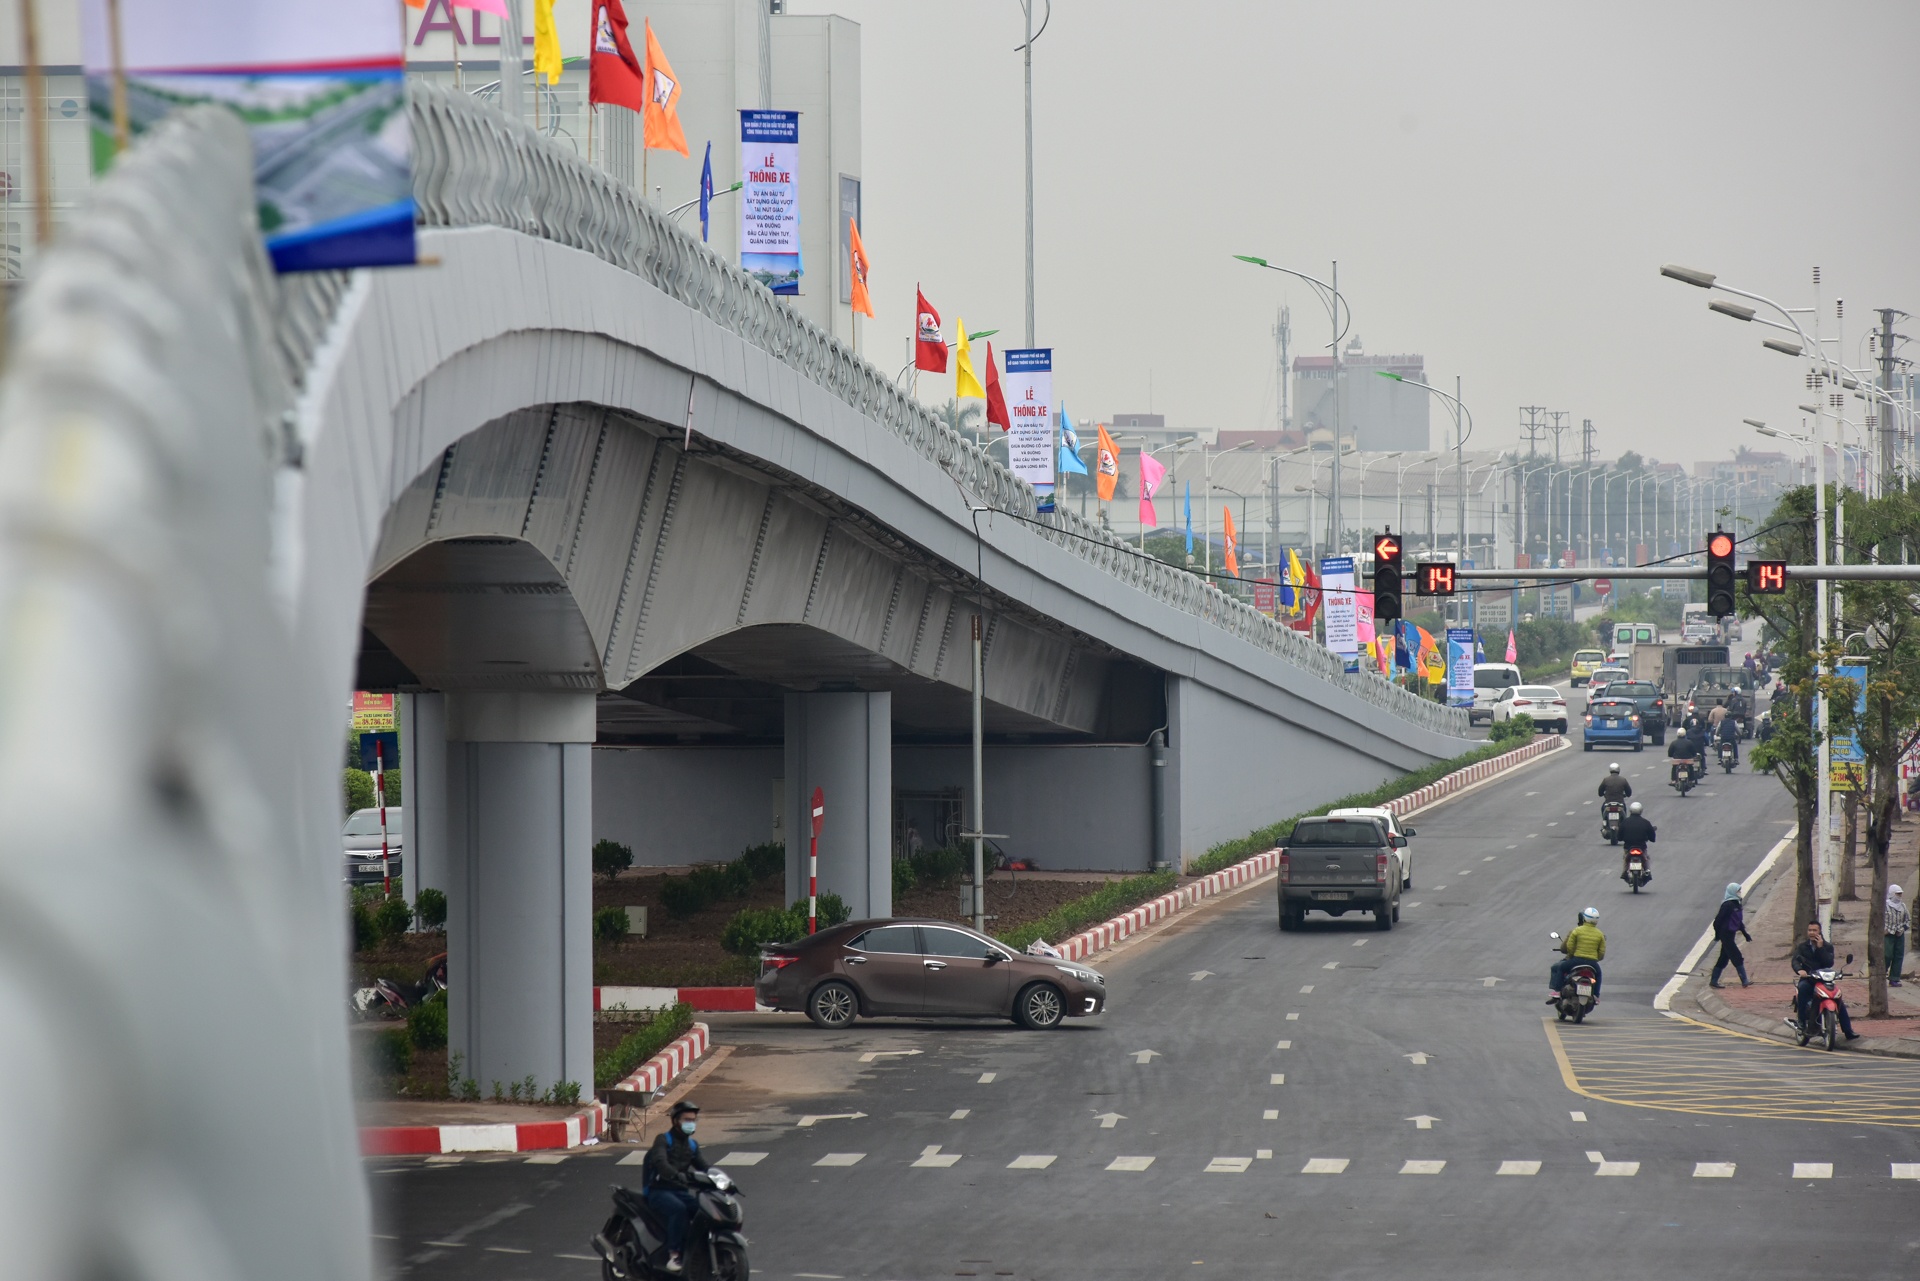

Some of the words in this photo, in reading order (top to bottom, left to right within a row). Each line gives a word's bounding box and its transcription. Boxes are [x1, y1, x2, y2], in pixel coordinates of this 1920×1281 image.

[765, 153, 774, 167] LỄ
[749, 169, 776, 182] THÔNG
[779, 172, 790, 183] XE
[1025, 386, 1034, 400] LỄ
[1013, 404, 1036, 417] THÔNG
[1038, 406, 1047, 417] XE
[1430, 568, 1452, 592] 14
[1760, 565, 1783, 589] 14
[1328, 597, 1344, 606] THÔNG
